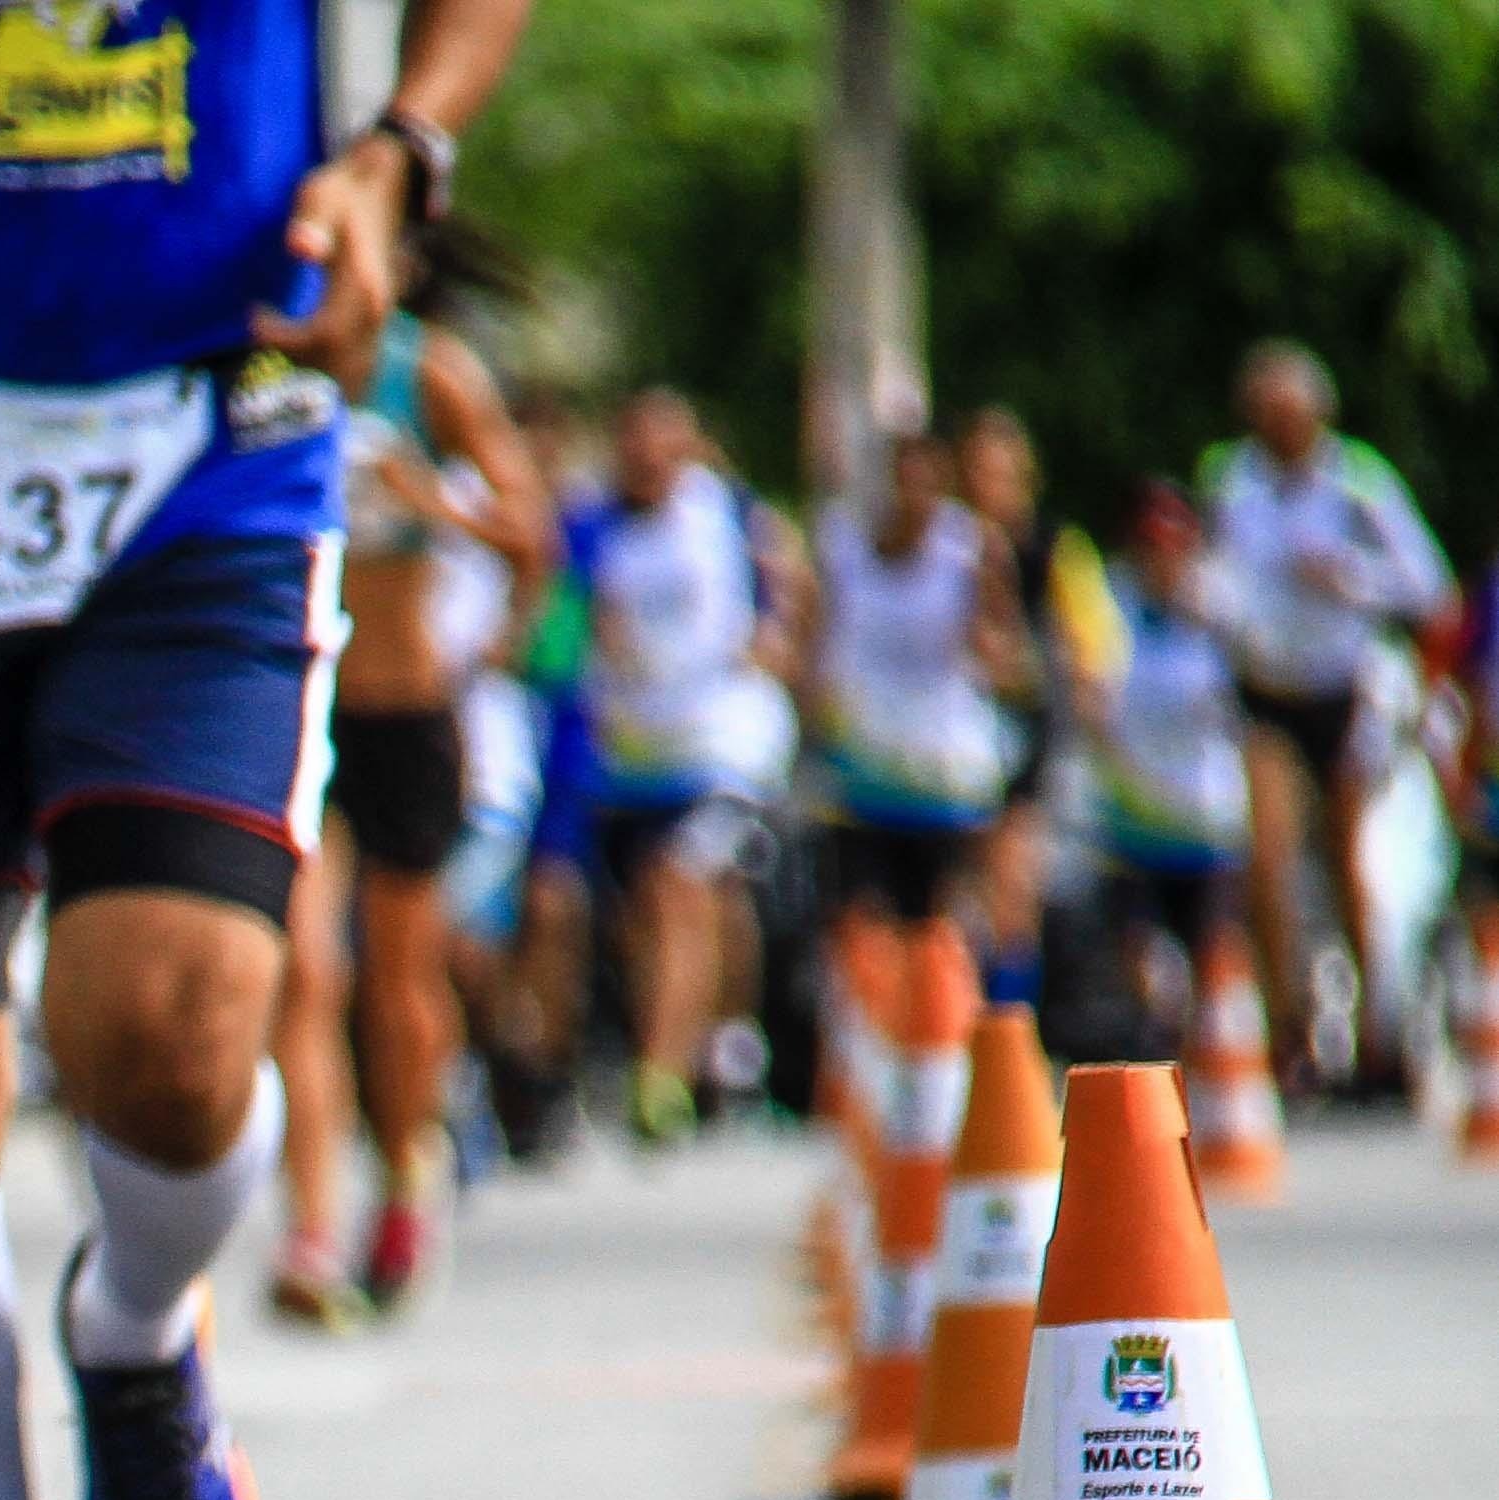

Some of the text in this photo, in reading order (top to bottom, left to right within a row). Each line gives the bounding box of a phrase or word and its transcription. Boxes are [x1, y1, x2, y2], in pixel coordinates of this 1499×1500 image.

[1083, 1429, 1177, 1444] PREFEITURA
[1083, 1445, 1202, 1473] MACEIÓ
[1081, 1480, 1144, 1500] Esporte
[1148, 1485, 1158, 1496] e
